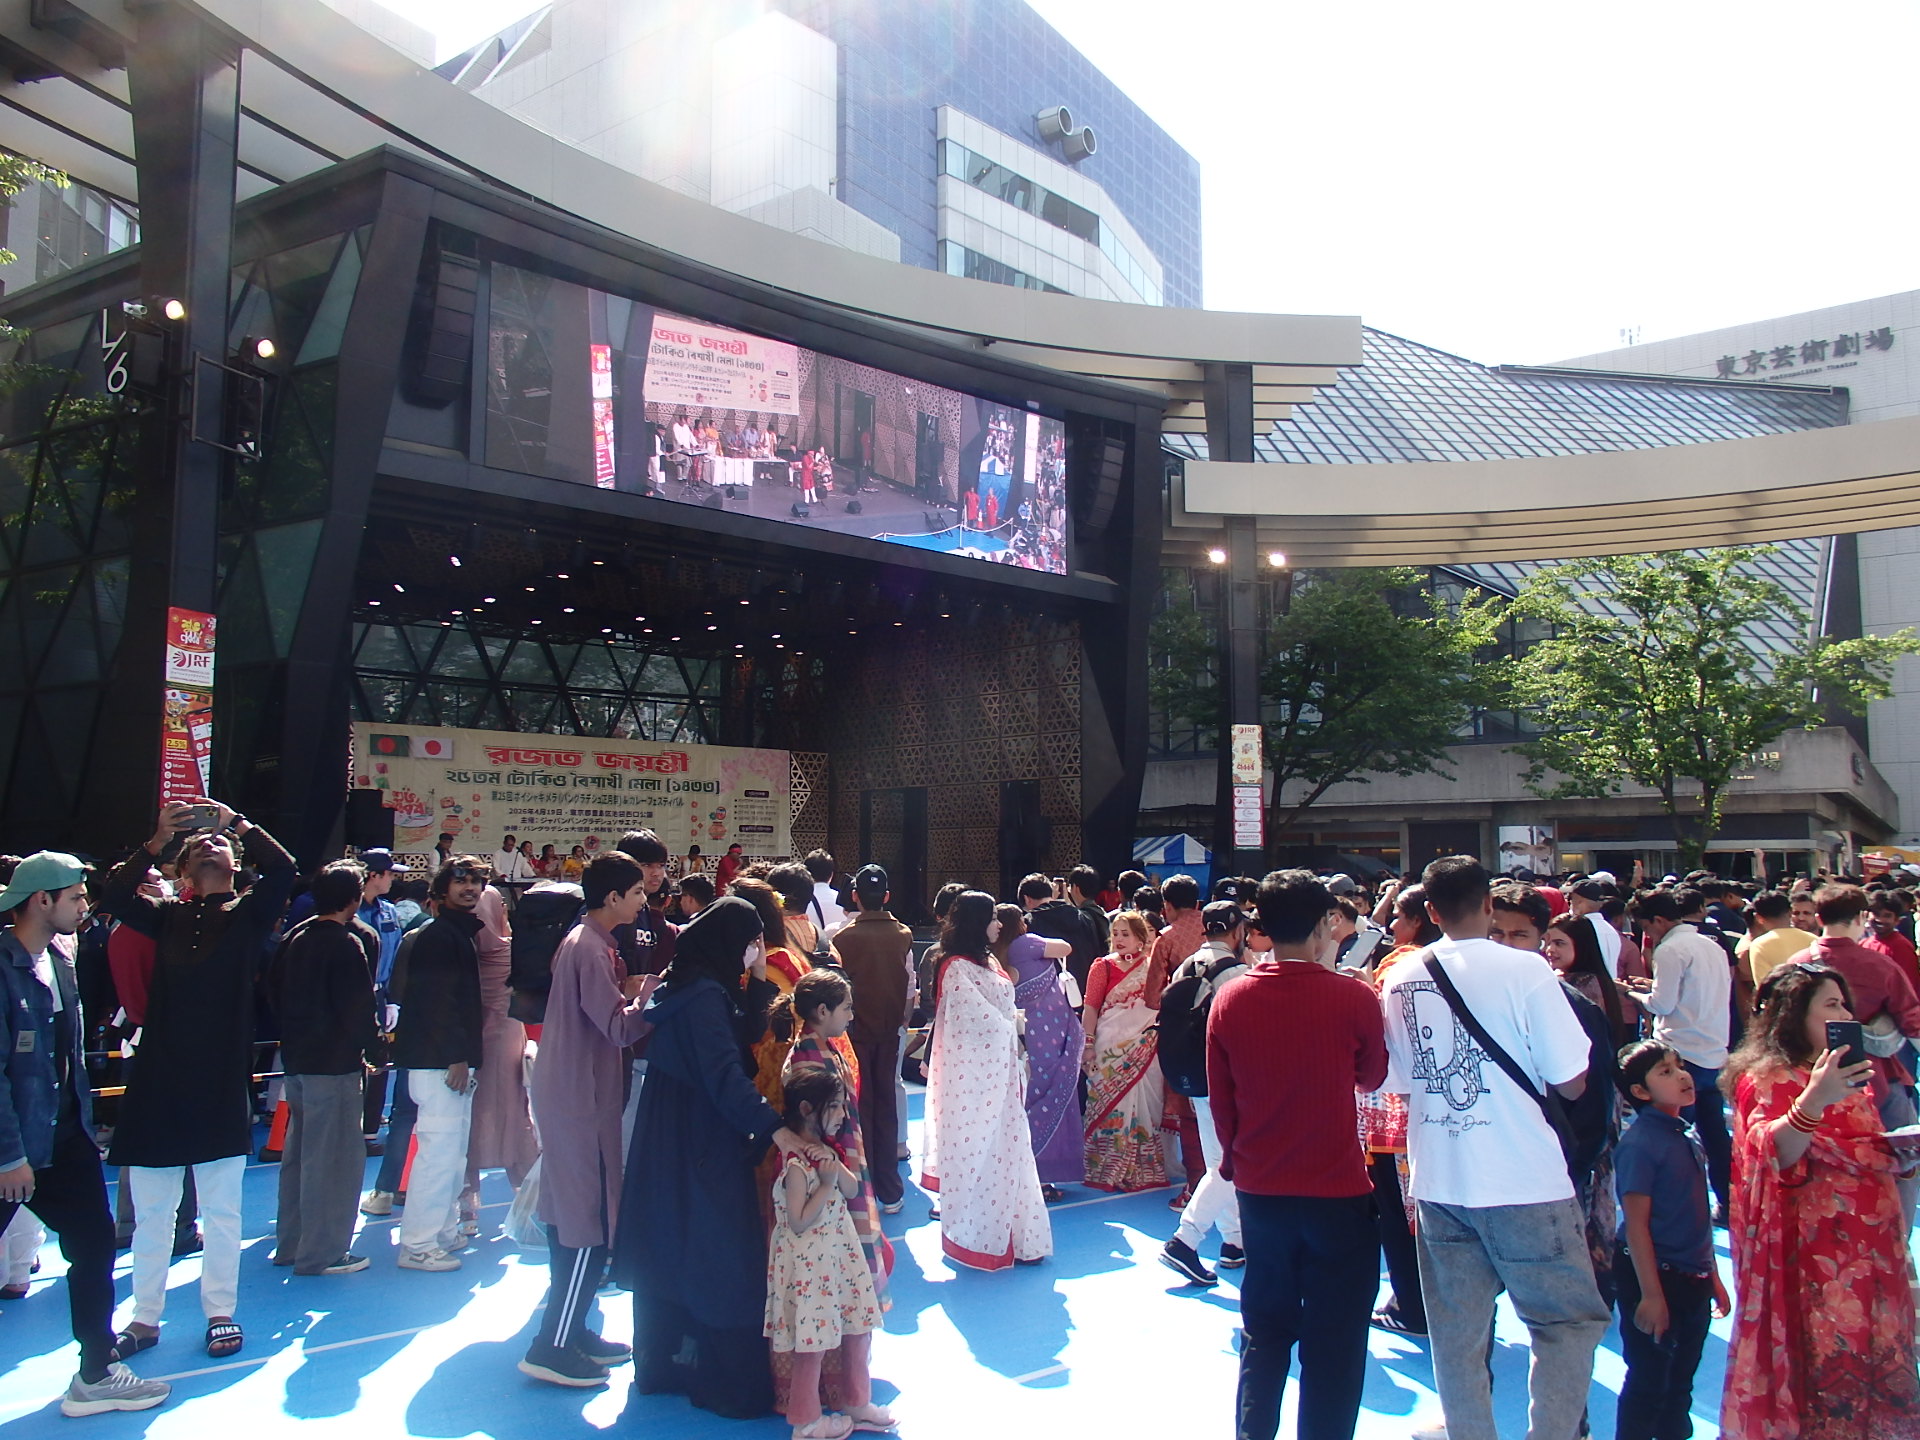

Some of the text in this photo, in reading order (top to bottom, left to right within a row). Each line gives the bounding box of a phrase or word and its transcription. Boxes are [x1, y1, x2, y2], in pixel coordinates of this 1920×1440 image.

[1716, 327, 1895, 379] 東京芸術劇場
[1826, 361, 1858, 371] Theatre
[187, 653, 211, 668] JRF
[484, 746, 691, 774] রজত জয়ন্তী
[629, 778, 661, 791] মেলা
[1461, 1114, 1492, 1131] Dior
[211, 1325, 241, 1337] NIKE
